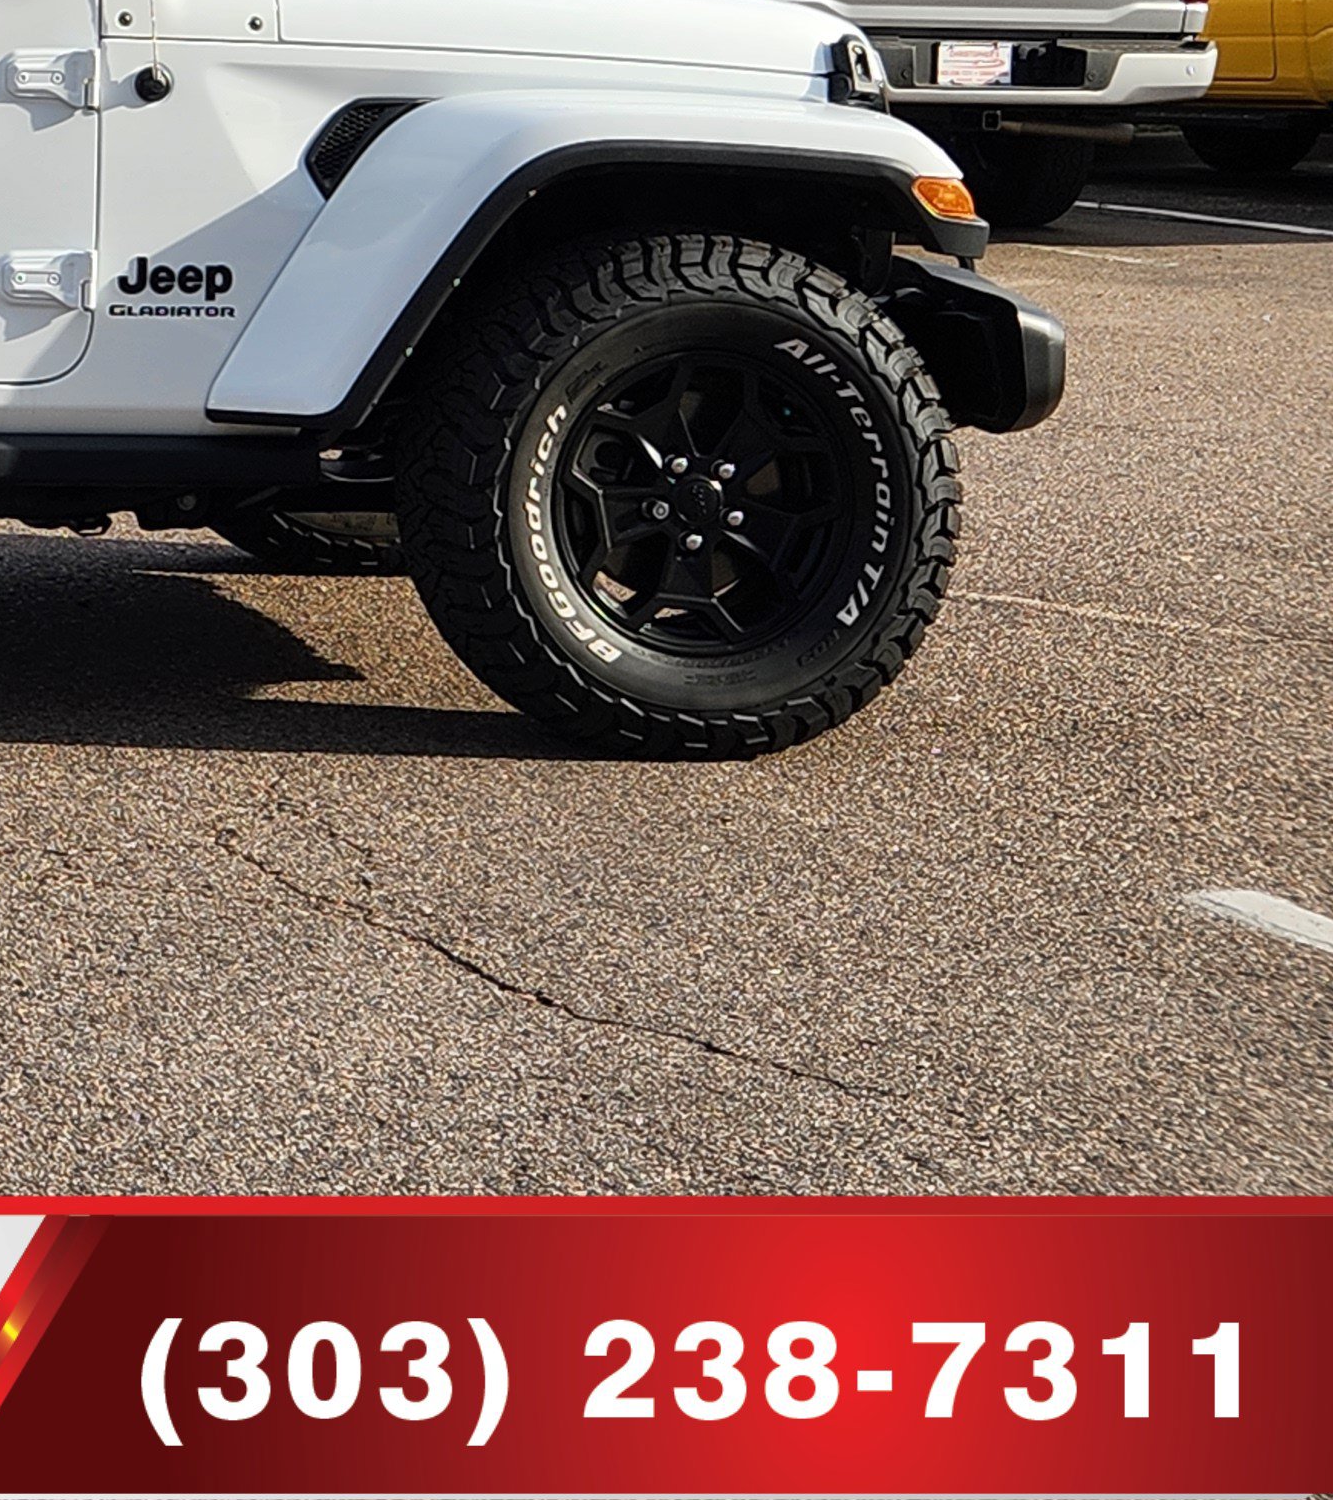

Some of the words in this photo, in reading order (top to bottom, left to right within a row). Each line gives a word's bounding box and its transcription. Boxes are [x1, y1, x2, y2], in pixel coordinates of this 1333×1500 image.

[108, 304, 236, 318] GLADIATOR
[117, 256, 234, 302] Jeep
[522, 404, 624, 665] BFGoodrich
[773, 338, 896, 554] All-Terrain
[835, 561, 885, 627] T/A
